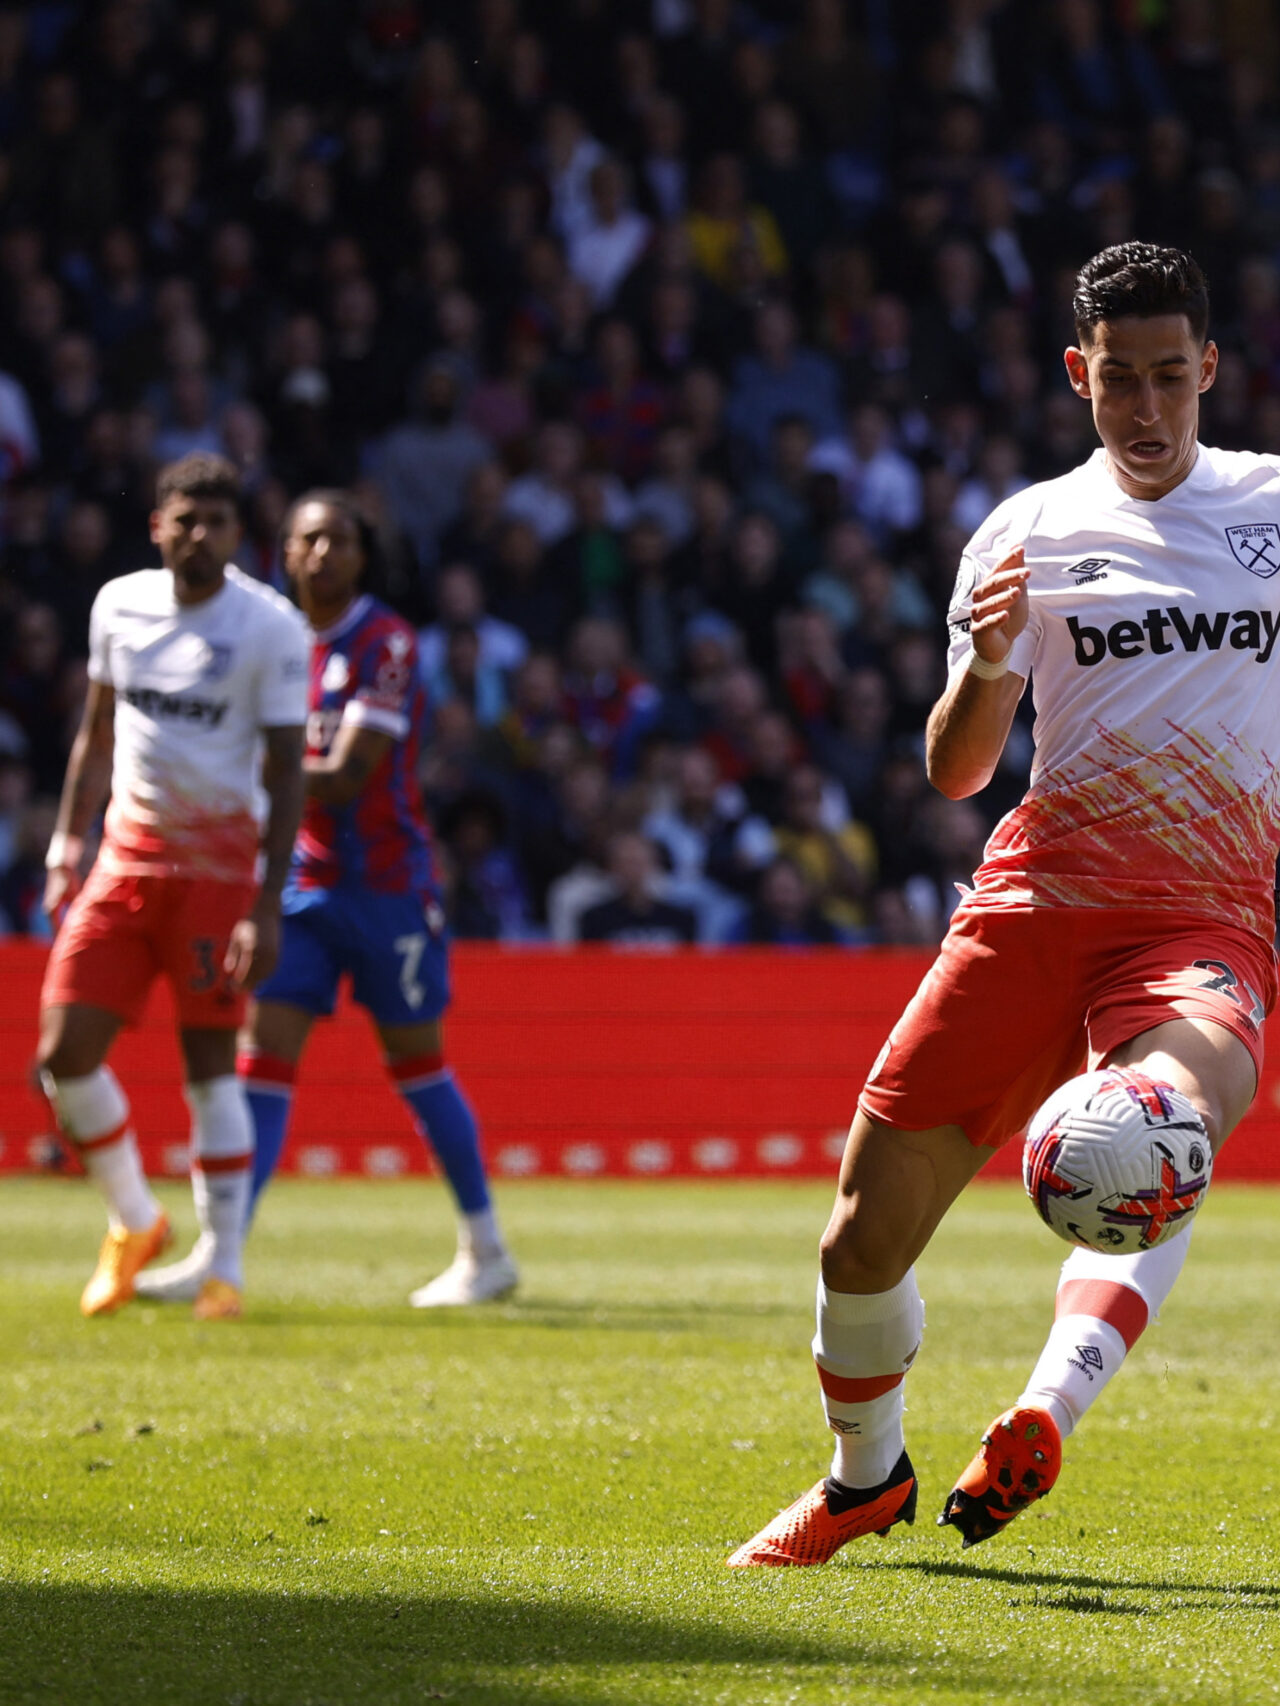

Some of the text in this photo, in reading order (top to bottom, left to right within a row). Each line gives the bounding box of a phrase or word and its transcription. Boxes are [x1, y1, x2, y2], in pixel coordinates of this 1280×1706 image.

[1231, 526, 1274, 536] WEST HAM
[1075, 572, 1108, 586] umbro
[393, 933, 427, 1011] 7
[1067, 1357, 1094, 1381] umbro
